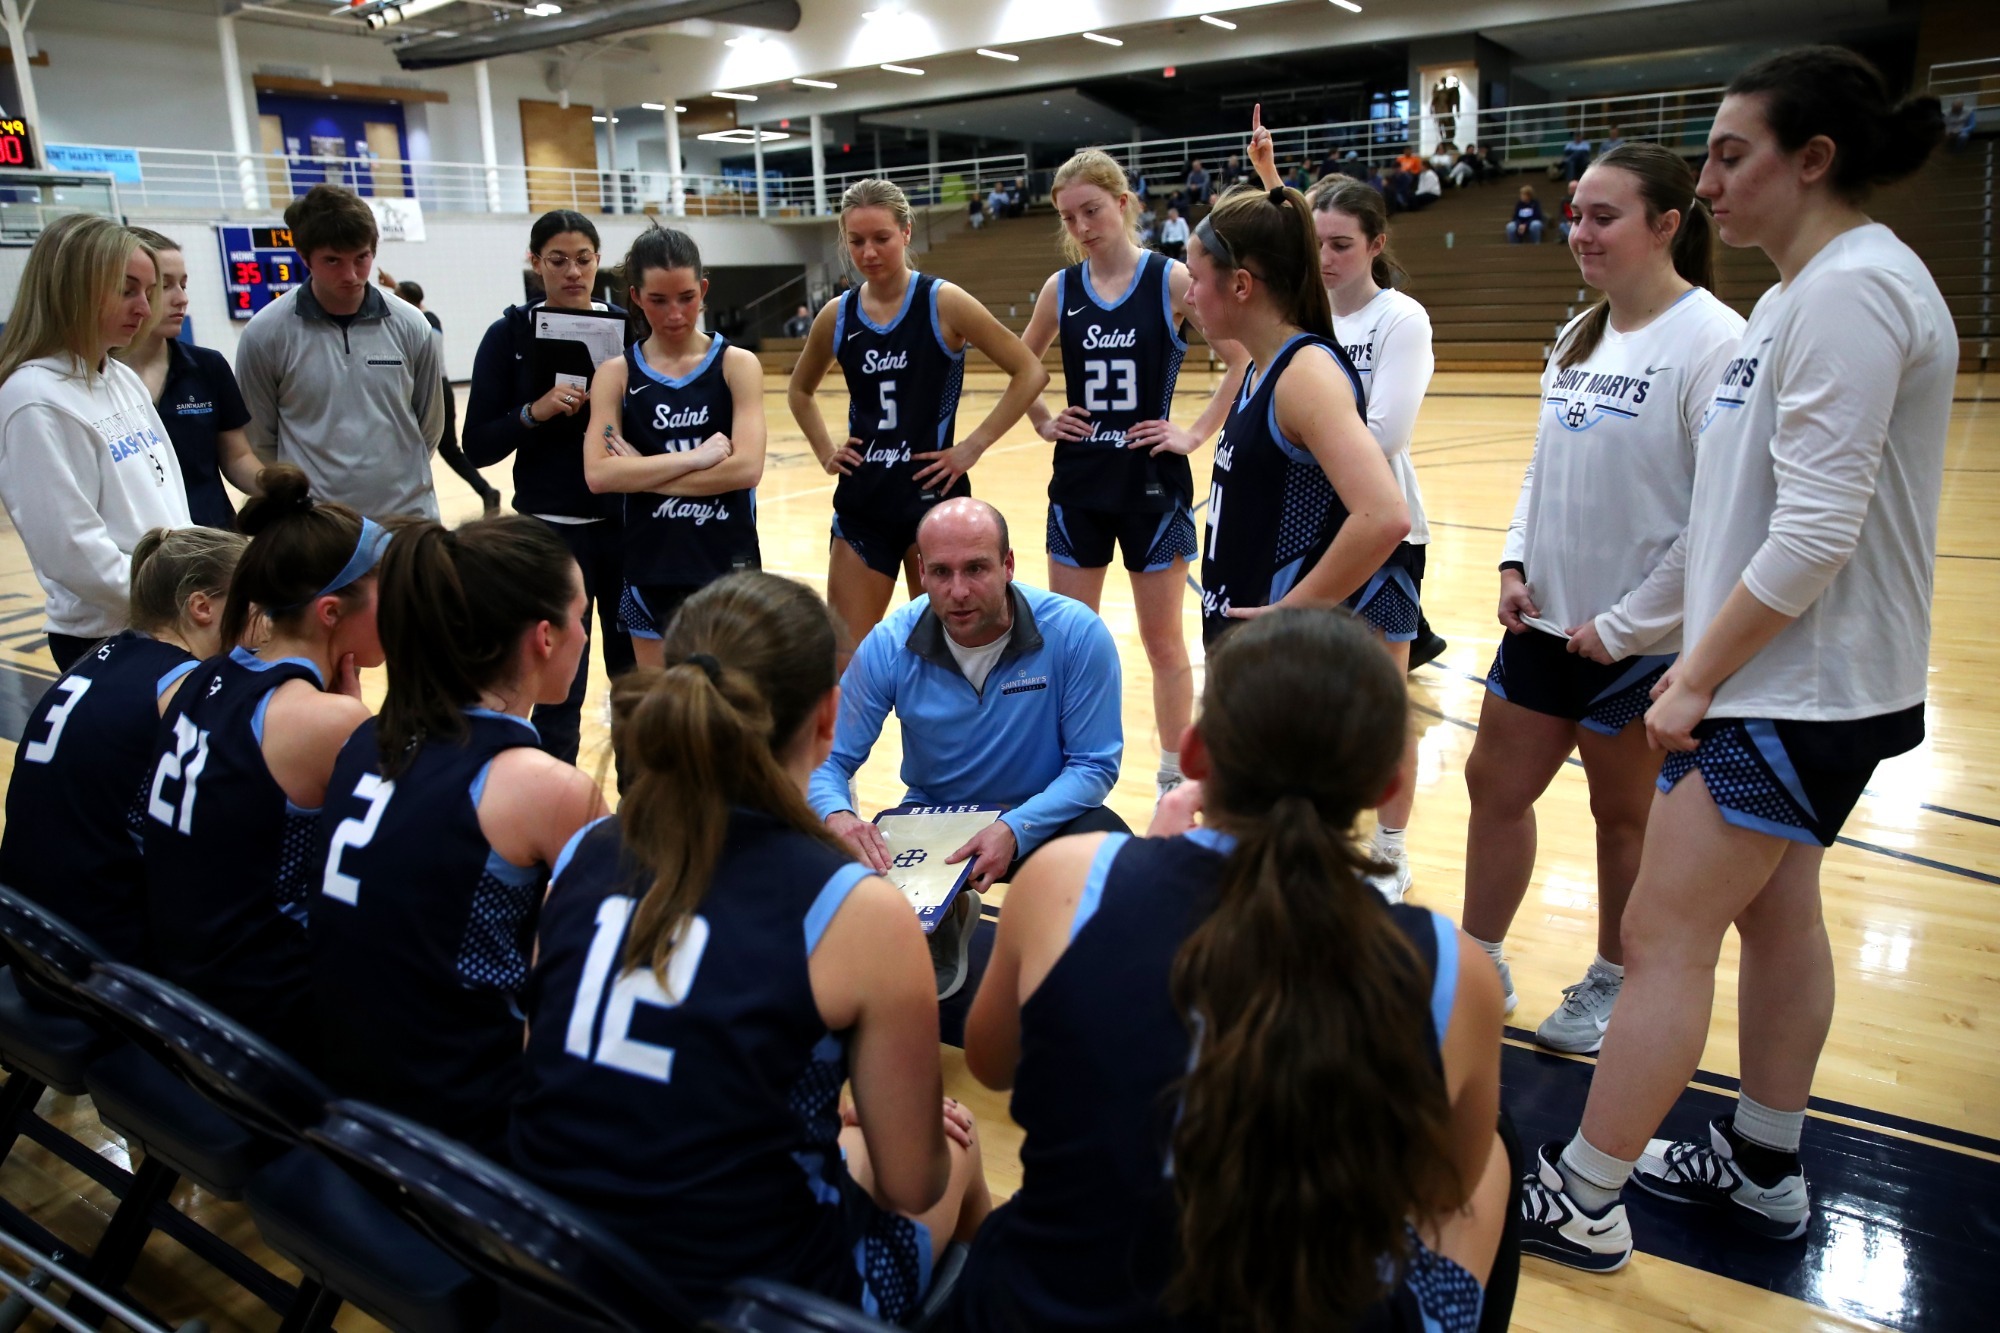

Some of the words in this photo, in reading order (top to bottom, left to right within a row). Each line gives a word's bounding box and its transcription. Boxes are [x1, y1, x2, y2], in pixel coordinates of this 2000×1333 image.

[270, 229, 294, 248] 1:4
[236, 262, 262, 284] 35
[278, 264, 289, 282] 3
[239, 291, 250, 309] 2
[1082, 324, 1136, 350] Saint
[862, 349, 908, 374] Saint
[1084, 359, 1138, 411] 23
[1552, 369, 1590, 391] SAINT
[1584, 374, 1650, 404] MARY'S
[652, 403, 709, 430] Saint
[877, 380, 898, 430] 5
[652, 497, 729, 526] Mary's
[1001, 680, 1021, 690] SAINT
[1022, 675, 1047, 686] MARY'S
[24, 674, 93, 764] 3
[148, 711, 211, 836] 21
[909, 804, 980, 815] BELLES
[322, 773, 396, 907] 2
[564, 894, 711, 1084] 12
